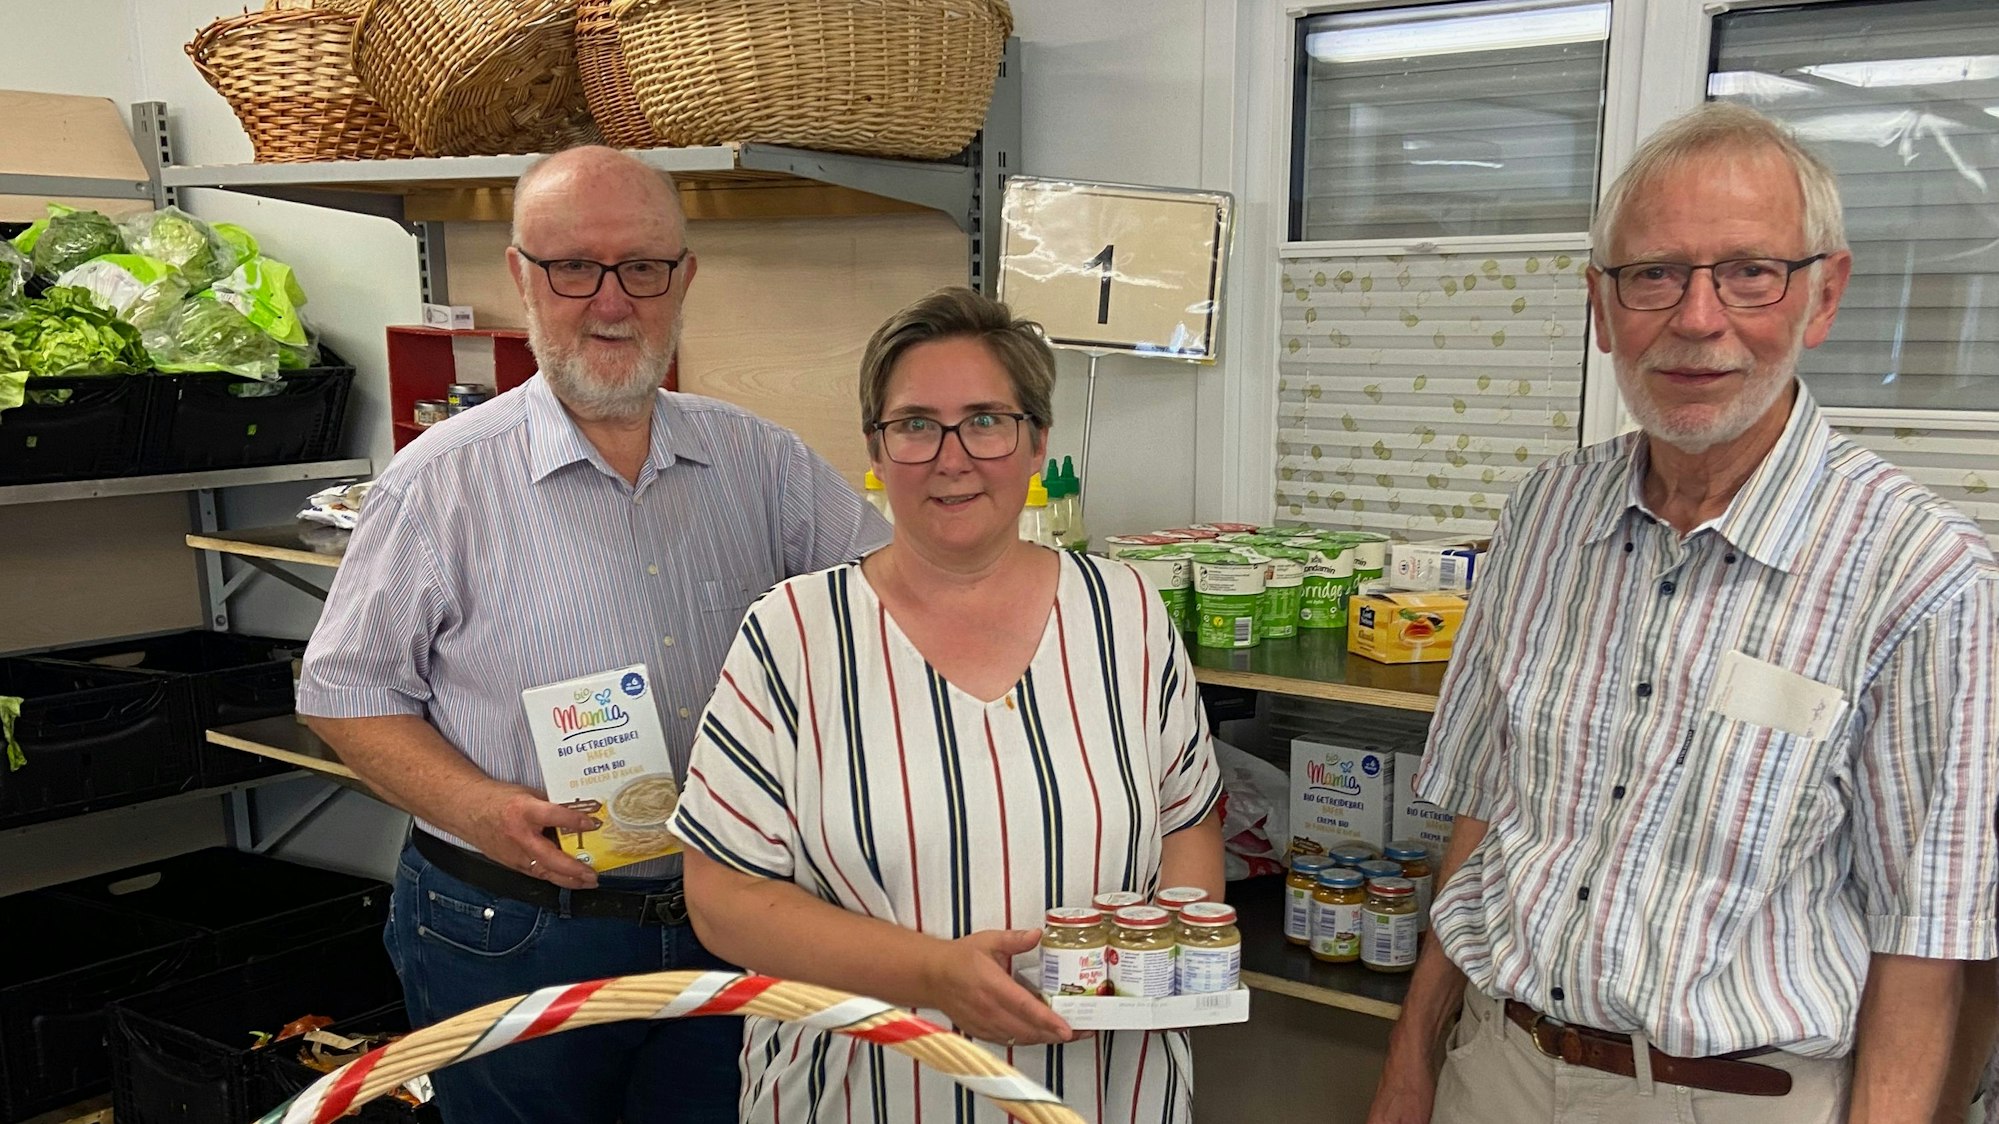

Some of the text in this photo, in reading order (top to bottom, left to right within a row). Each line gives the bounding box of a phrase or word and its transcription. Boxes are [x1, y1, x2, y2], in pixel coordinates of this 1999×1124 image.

[1083, 244, 1114, 324] 1
[1303, 564, 1336, 575] ondamin
[573, 687, 591, 701] bio
[553, 704, 630, 734] Mamia
[558, 730, 640, 758] BIO GETREIDEBREI
[583, 759, 627, 776] CREMA BIO
[1307, 760, 1361, 787] Mamia
[1303, 793, 1365, 811] BIO GETREIDEBREI
[1316, 816, 1337, 826] CREMA
[1406, 806, 1455, 822] BIO GETREIDE
